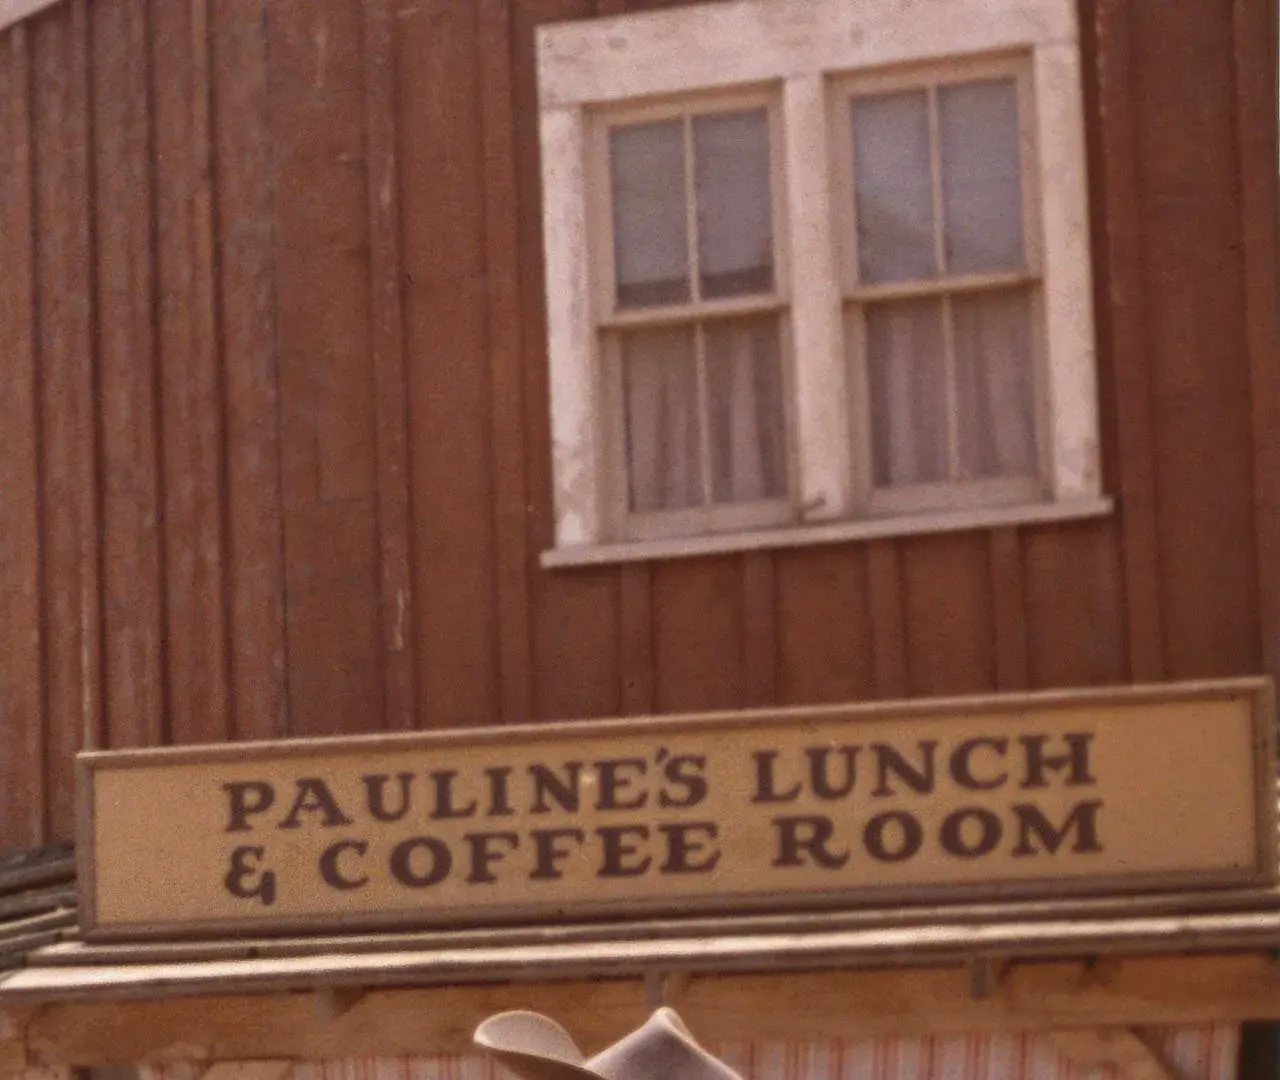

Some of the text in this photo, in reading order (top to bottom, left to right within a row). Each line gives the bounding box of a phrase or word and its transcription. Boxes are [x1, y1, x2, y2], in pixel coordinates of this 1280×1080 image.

[223, 732, 1096, 832] PAULINE'S LUNCH
[225, 800, 1104, 906] & COFFEE ROOM
